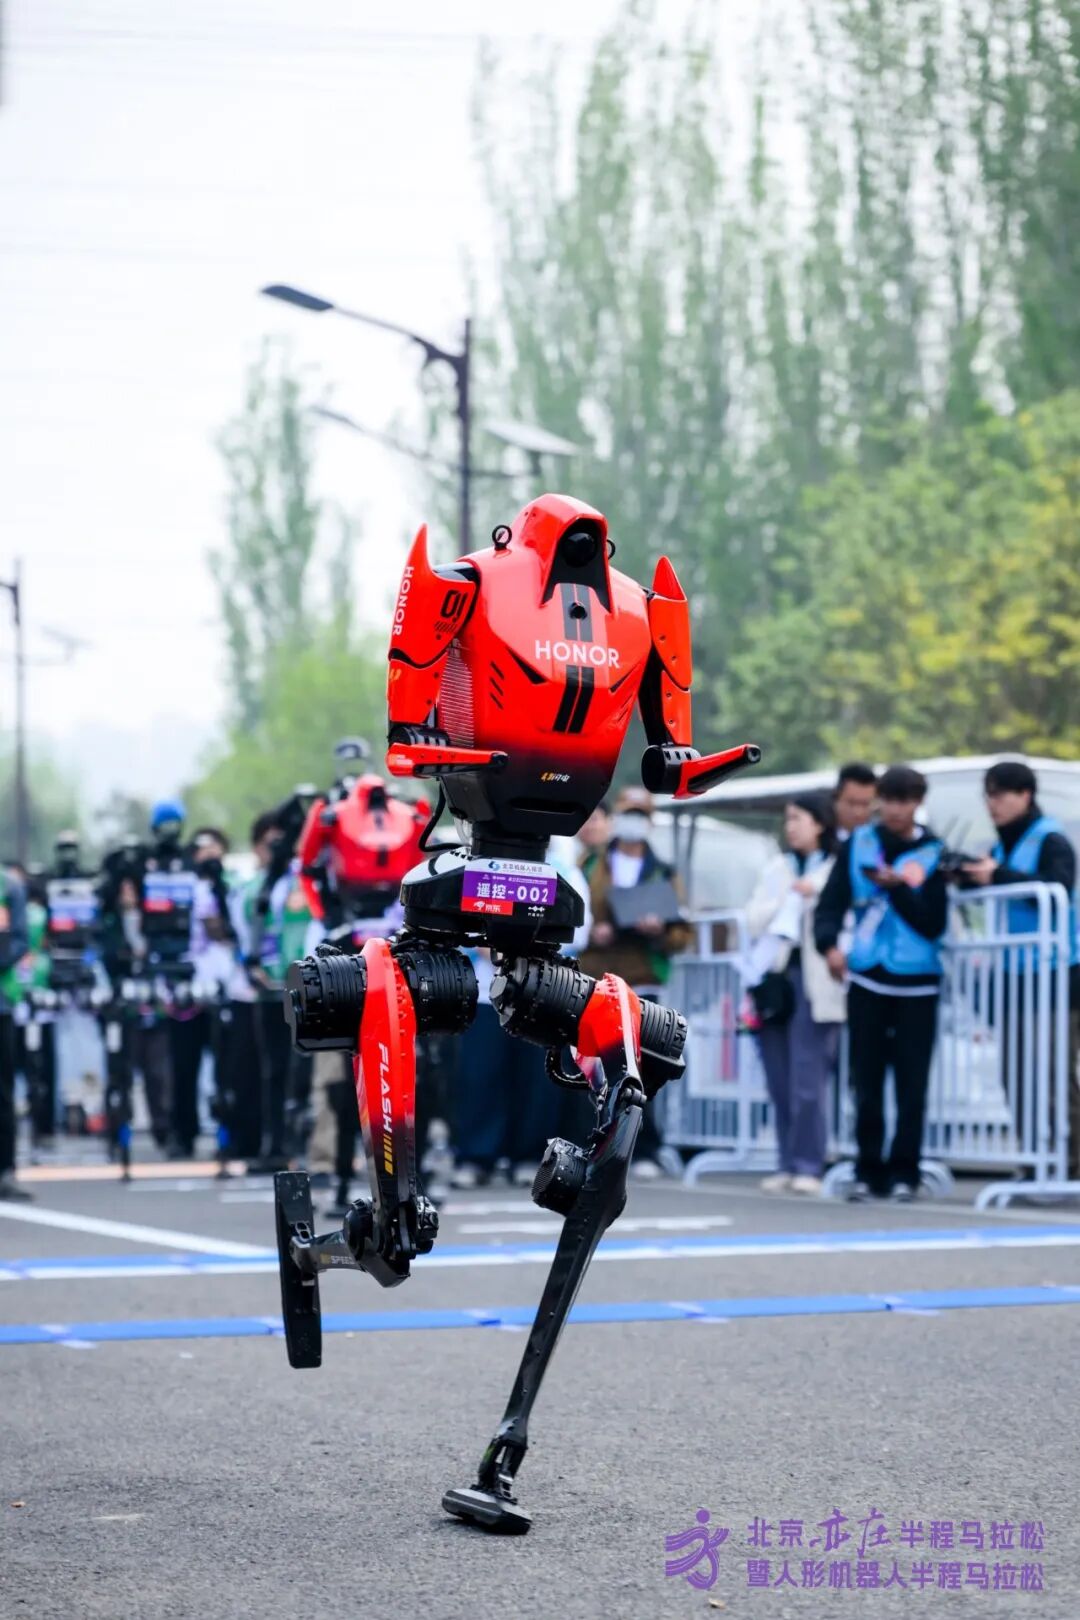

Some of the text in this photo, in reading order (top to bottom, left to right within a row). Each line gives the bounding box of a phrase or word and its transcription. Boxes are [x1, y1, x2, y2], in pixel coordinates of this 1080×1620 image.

[393, 566, 414, 636] HONOR
[535, 640, 619, 668] HONOR
[477, 882, 549, 903] 遥控-002
[378, 1042, 393, 1133] FLASH
